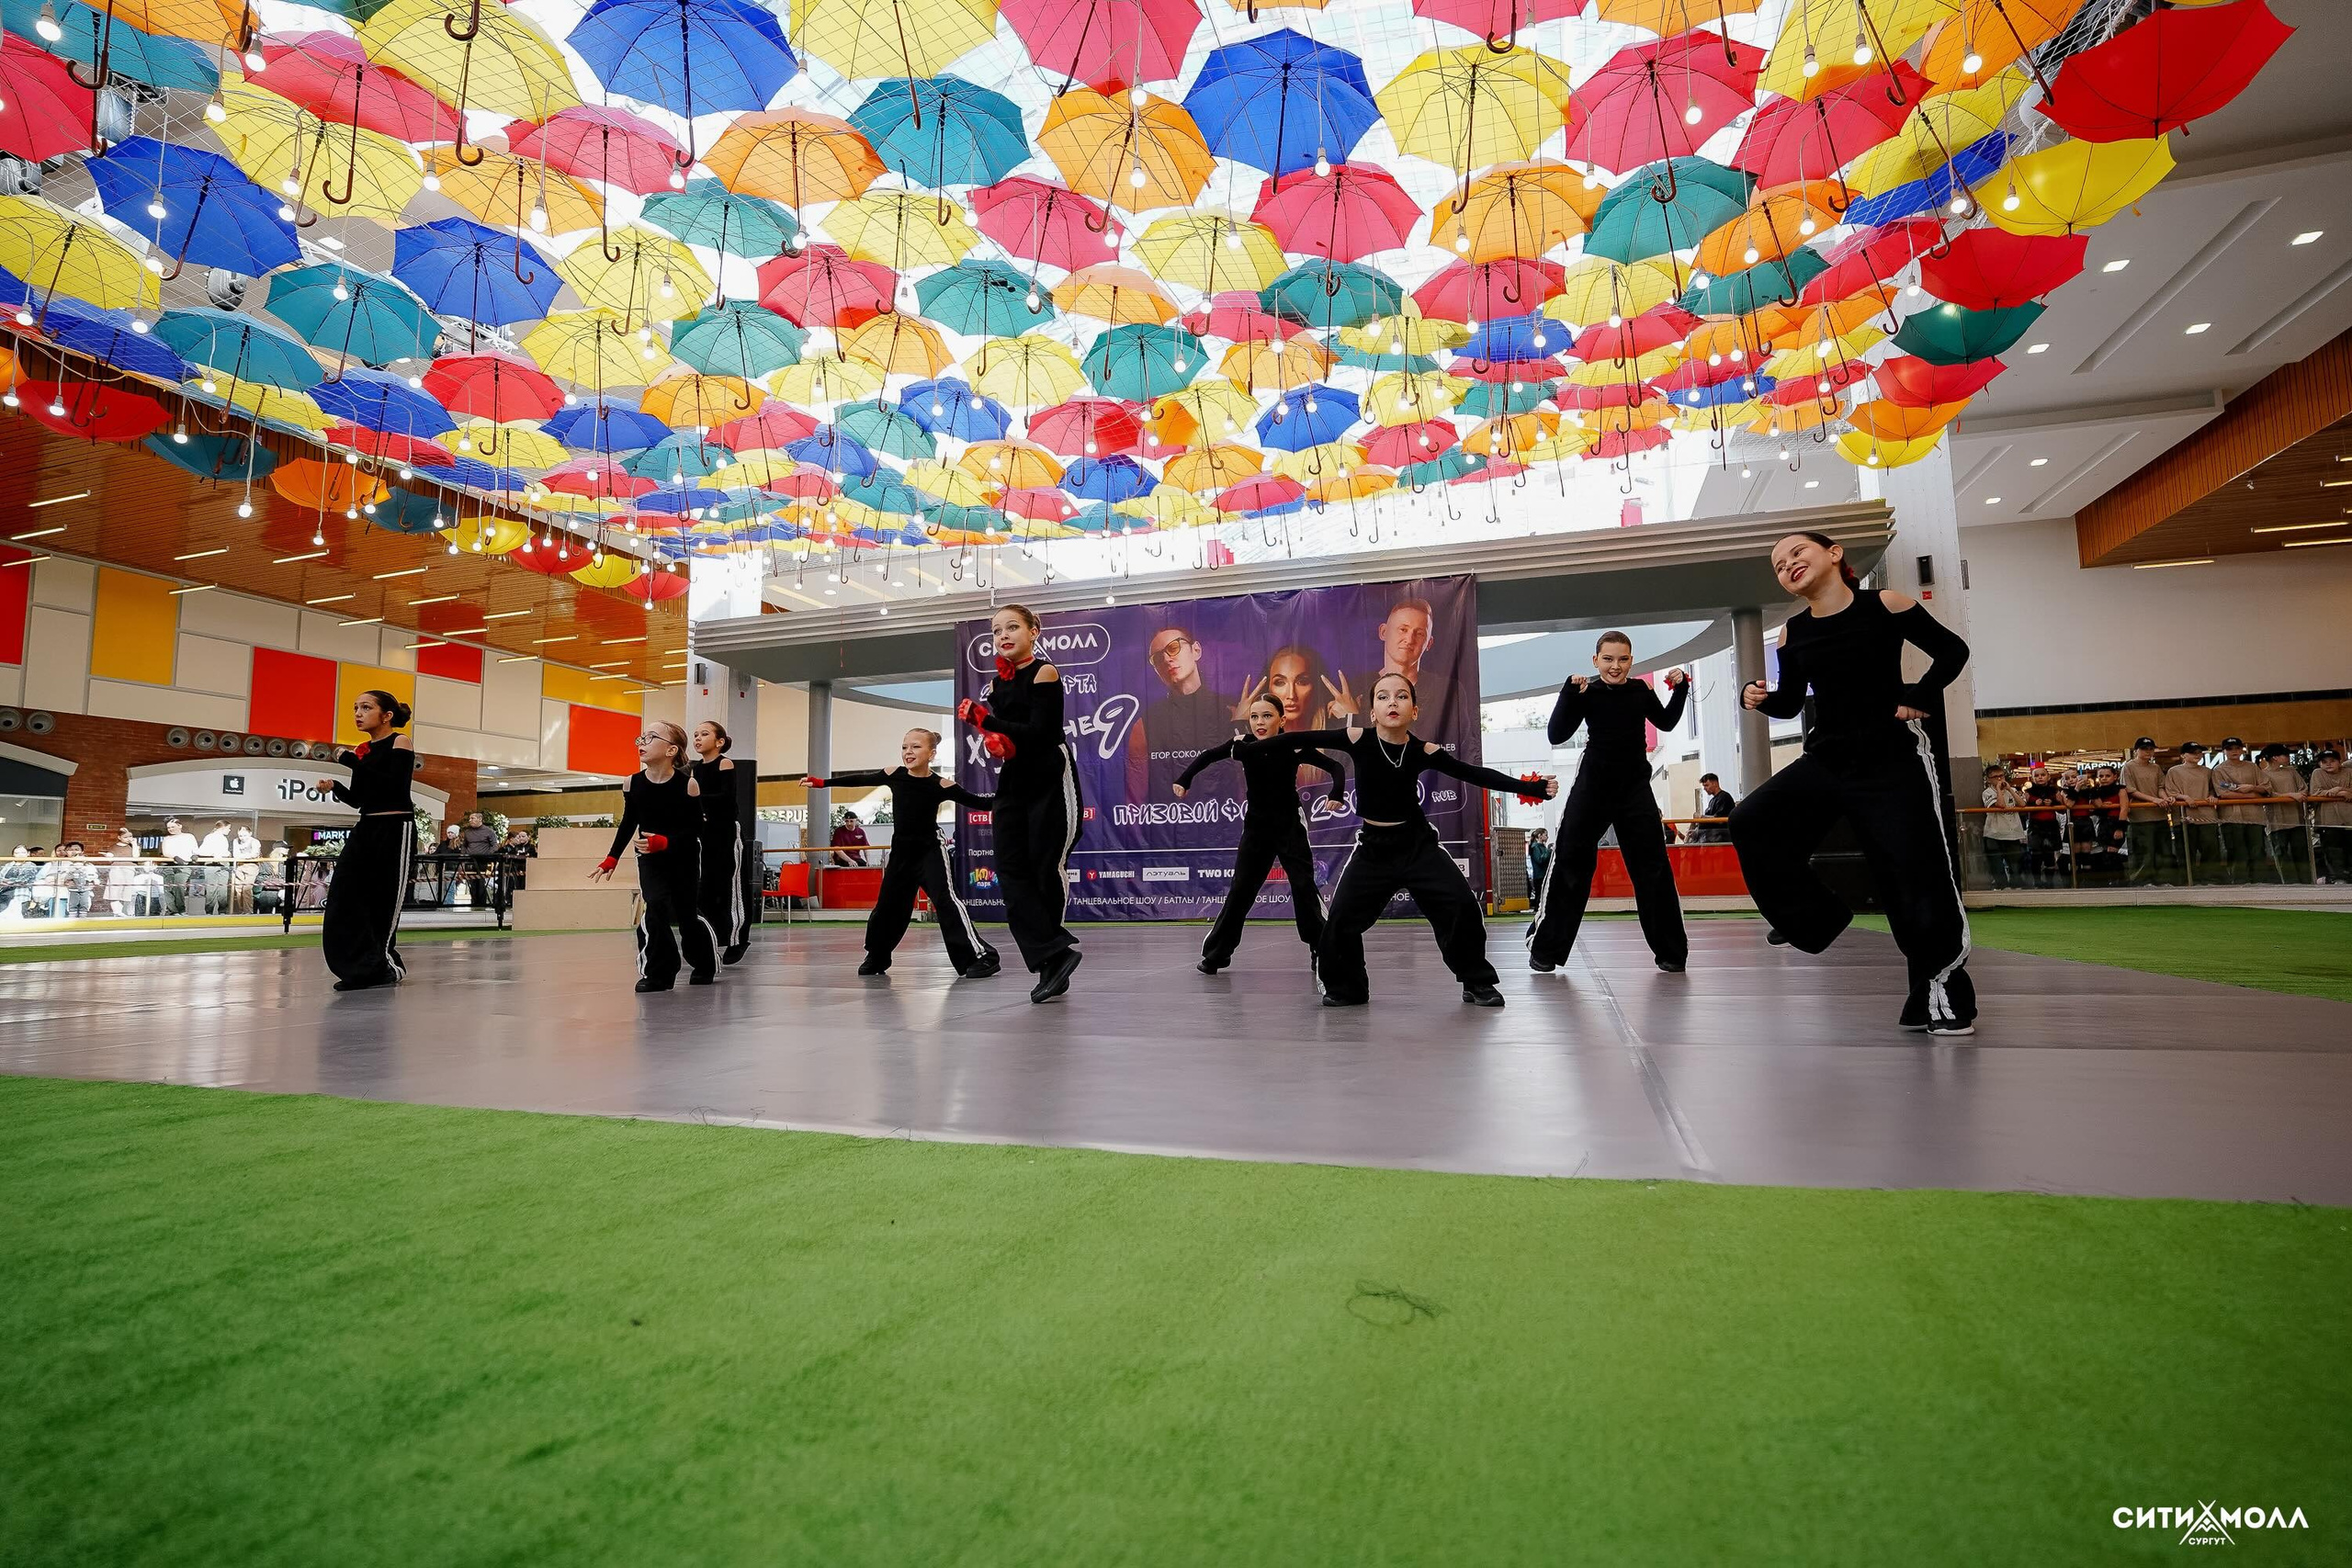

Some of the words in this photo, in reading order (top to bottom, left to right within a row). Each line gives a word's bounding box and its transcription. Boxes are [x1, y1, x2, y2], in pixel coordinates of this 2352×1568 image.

[1150, 751, 1170, 760] ЕГОР
[1113, 798, 1219, 826] ПРИЗОВОЙ
[1098, 870, 1136, 879] YAMAGUCHI
[1197, 869, 1223, 878] TWO
[1073, 897, 1135, 906] ТАНЦЕВАЛЬНОЕ
[1136, 897, 1157, 905] ШОУ
[1164, 896, 1194, 905] БАТТЛЫ
[1269, 895, 1291, 903] ШОУ
